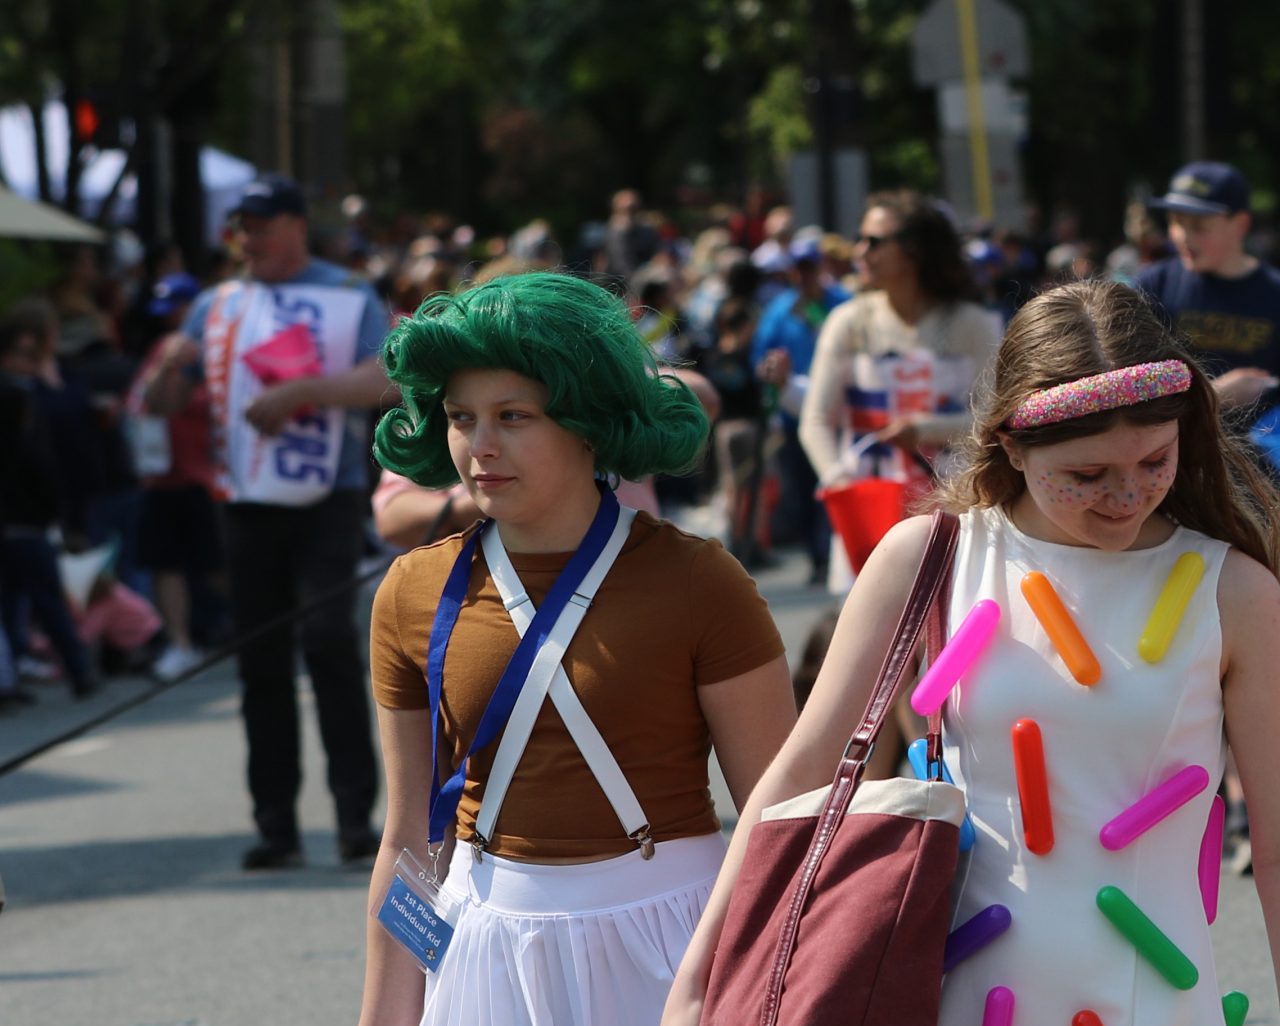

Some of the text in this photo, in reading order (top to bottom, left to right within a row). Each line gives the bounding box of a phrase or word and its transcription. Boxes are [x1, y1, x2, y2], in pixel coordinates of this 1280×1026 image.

[390, 896, 427, 935] Individual
[426, 931, 441, 948] Kid
[405, 892, 437, 927] 1st Place
